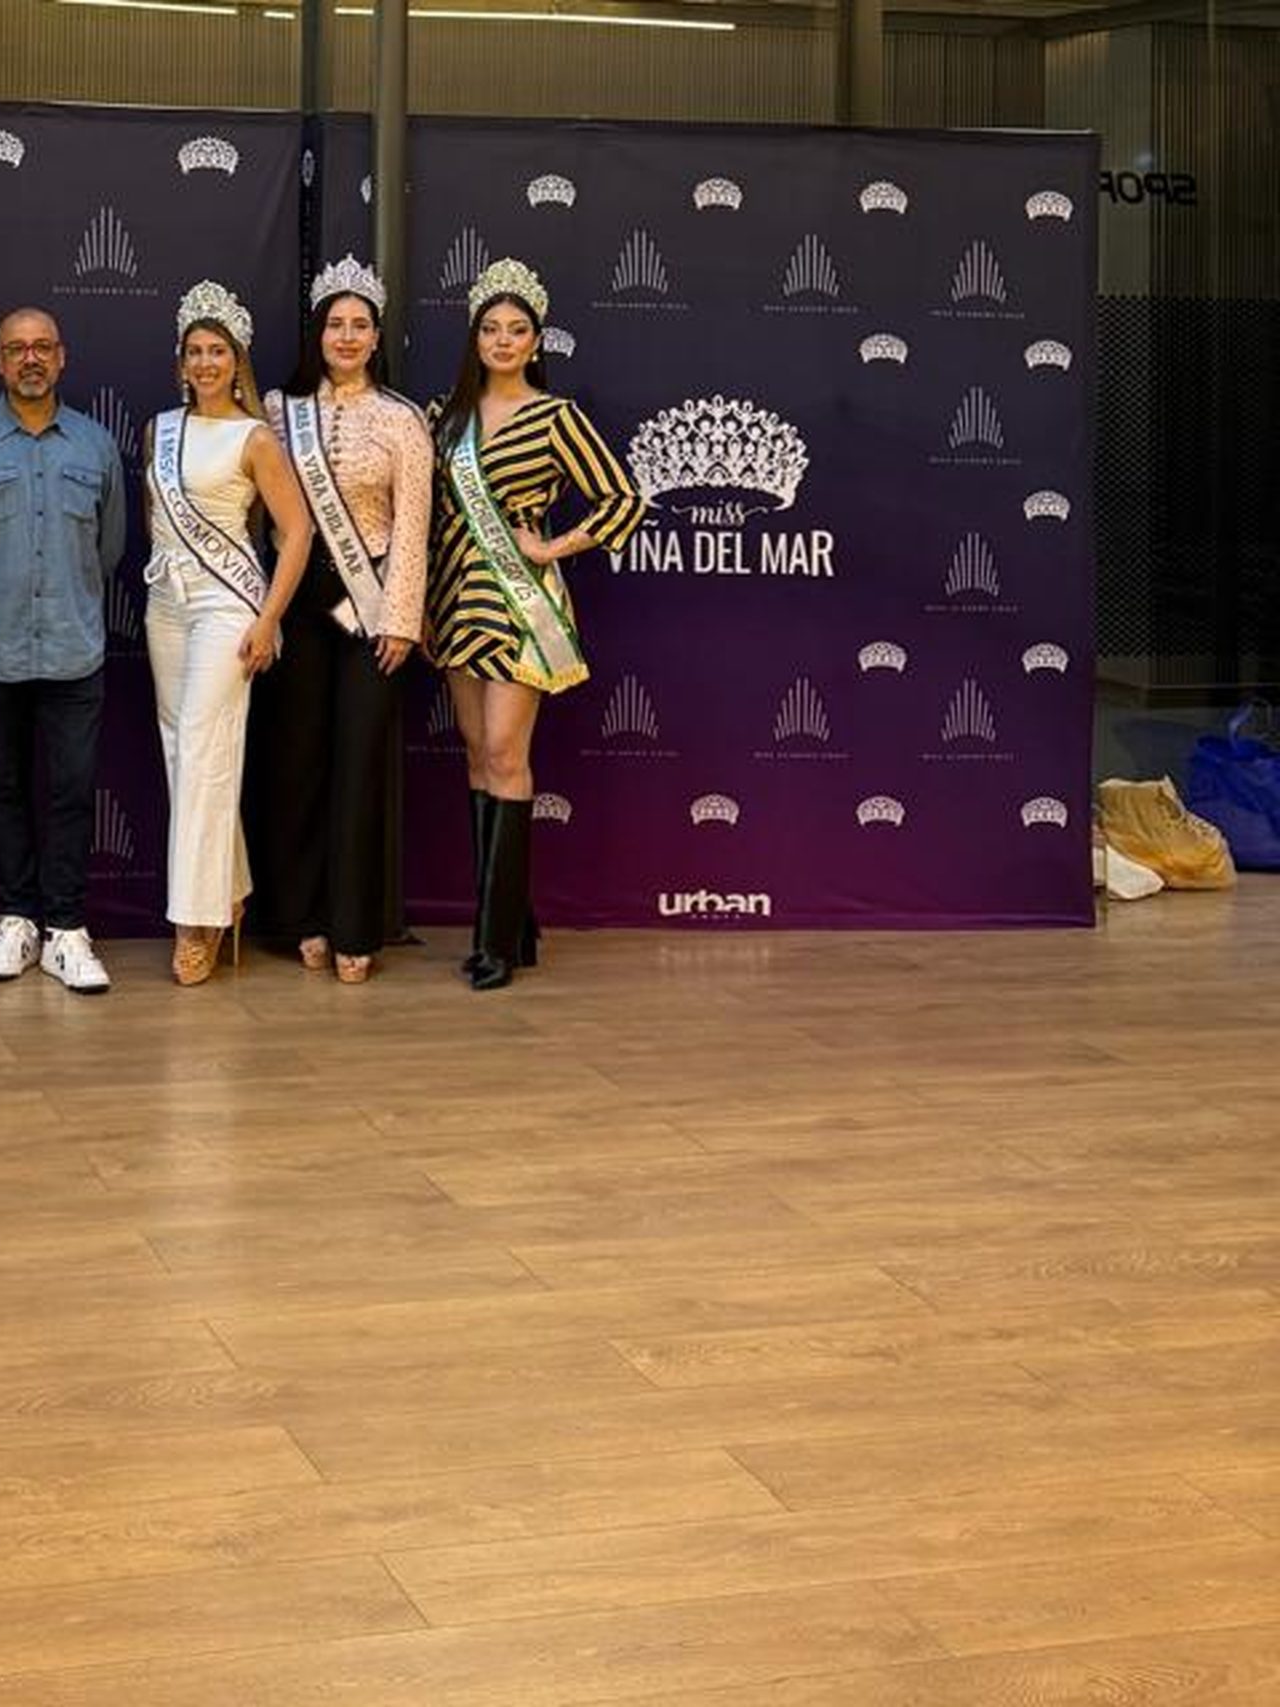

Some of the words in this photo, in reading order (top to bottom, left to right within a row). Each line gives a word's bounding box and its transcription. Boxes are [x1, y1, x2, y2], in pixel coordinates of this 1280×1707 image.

[167, 486, 222, 553] COSMO
[220, 551, 262, 600] VIÑA
[321, 501, 346, 536] DEL
[337, 537, 365, 578] MAR
[694, 531, 751, 574] DEL
[761, 530, 834, 577] MAR
[658, 889, 771, 917] urban
